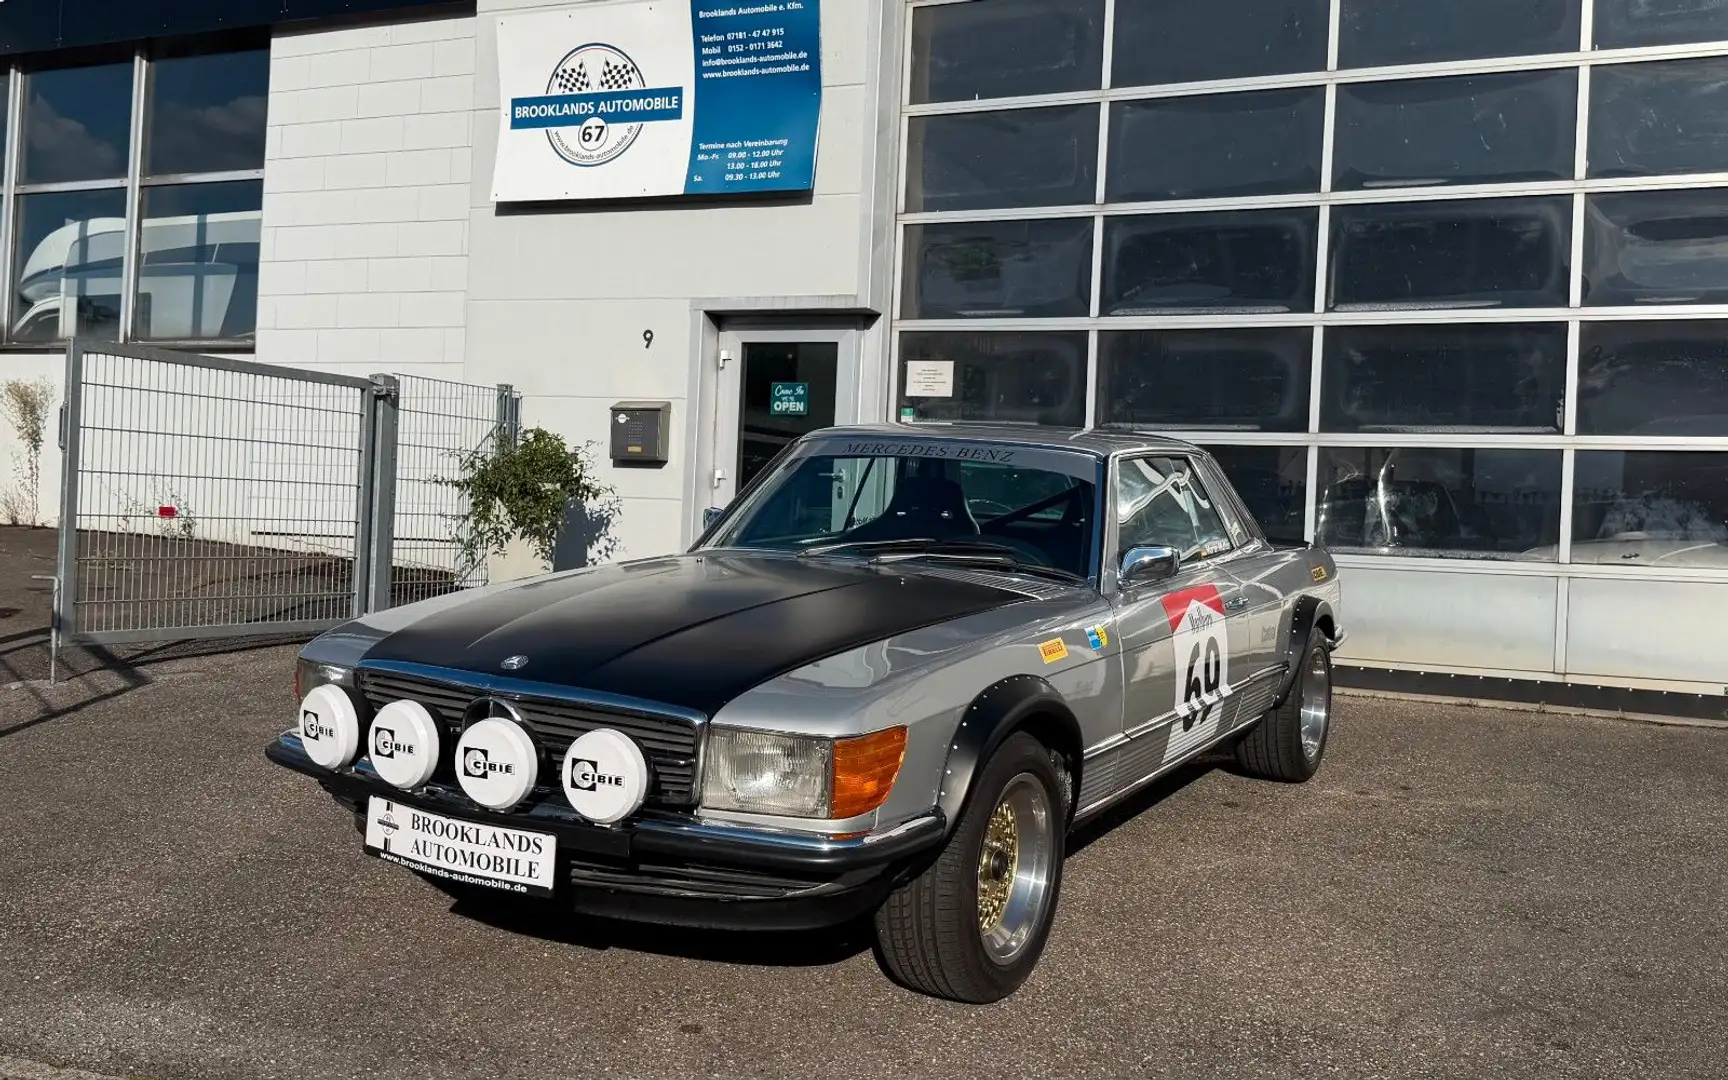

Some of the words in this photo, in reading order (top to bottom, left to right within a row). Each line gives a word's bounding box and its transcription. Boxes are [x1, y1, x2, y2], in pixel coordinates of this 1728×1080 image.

[698, 8, 737, 18] Brooklands
[738, 4, 778, 15] Automobile
[787, 2, 804, 10] Kfm.
[701, 34, 725, 43] Telefon
[726, 31, 747, 40] 07181
[752, 30, 761, 38] 47
[762, 29, 771, 37] 47
[771, 28, 785, 36] 915
[702, 46, 721, 55] Mobil
[728, 44, 744, 53] 0152
[749, 42, 766, 51] 0171
[766, 41, 783, 49] 3642
[702, 51, 808, 67] info@brooklands-automobile.de
[703, 63, 810, 79] www.brooklands-automobile.de
[514, 101, 595, 119] BROOKLANDS
[597, 96, 679, 114] AUTOMOBILE
[581, 125, 605, 143] 67
[698, 142, 725, 151] Termine
[726, 140, 742, 149] nach
[743, 138, 789, 148] Vereinbarung
[727, 151, 747, 159] 09.00
[752, 150, 770, 158] 12.00
[770, 148, 784, 156] Uhr
[726, 162, 746, 170] 13.00
[693, 174, 704, 182] Sa.
[724, 173, 744, 181] 09.30
[749, 171, 767, 180] 13.00
[767, 170, 781, 178] Uhr
[642, 329, 654, 349] 9
[774, 384, 793, 397] Come
[773, 401, 804, 412] OPEN
[842, 442, 950, 457] MERCEDES
[956, 448, 1015, 463] BENZ
[1043, 642, 1063, 656] PIRELLI
[1182, 636, 1221, 733] 69
[411, 813, 543, 855] BROOKLANDS
[410, 838, 540, 880] AUTOMOBILE
[379, 851, 528, 893] www.brooklands-automobile.de
